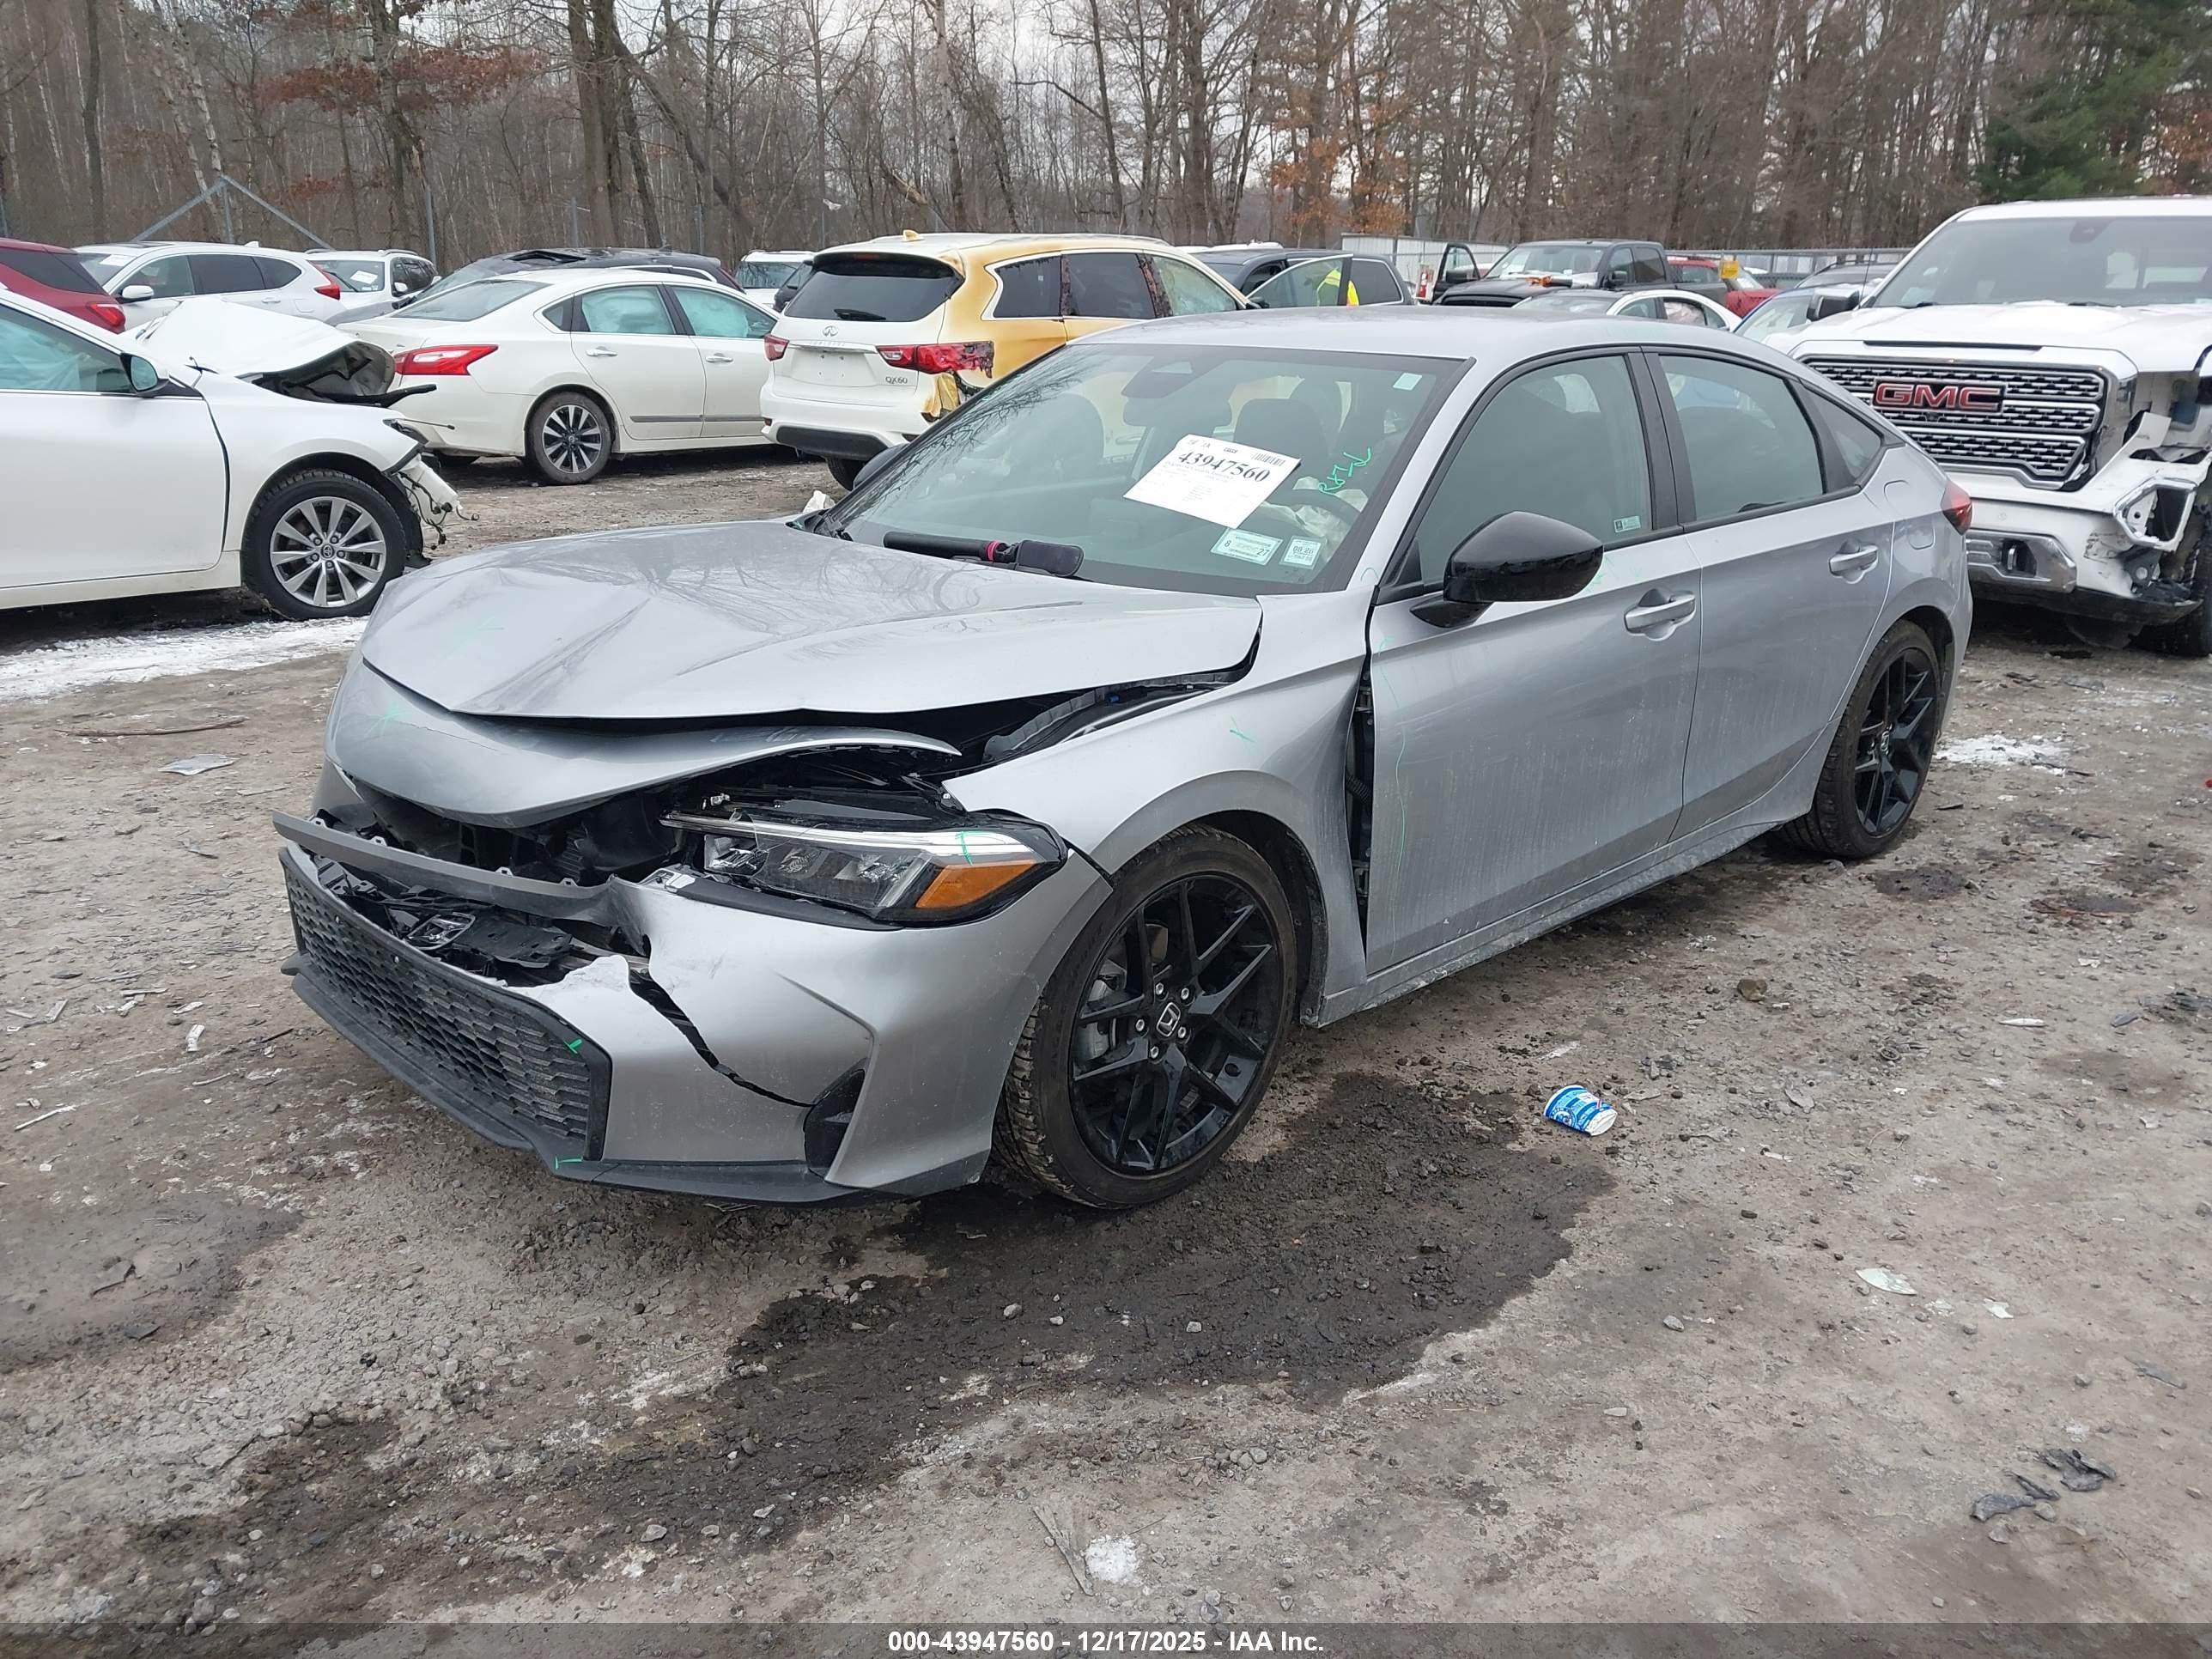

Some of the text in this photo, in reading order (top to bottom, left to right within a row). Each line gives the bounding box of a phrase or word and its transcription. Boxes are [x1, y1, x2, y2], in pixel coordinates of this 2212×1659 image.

[885, 376, 908, 385] QX60
[1875, 382, 2002, 411] GMC
[1177, 451, 1271, 483] 43947560
[1256, 548, 1271, 556] 27
